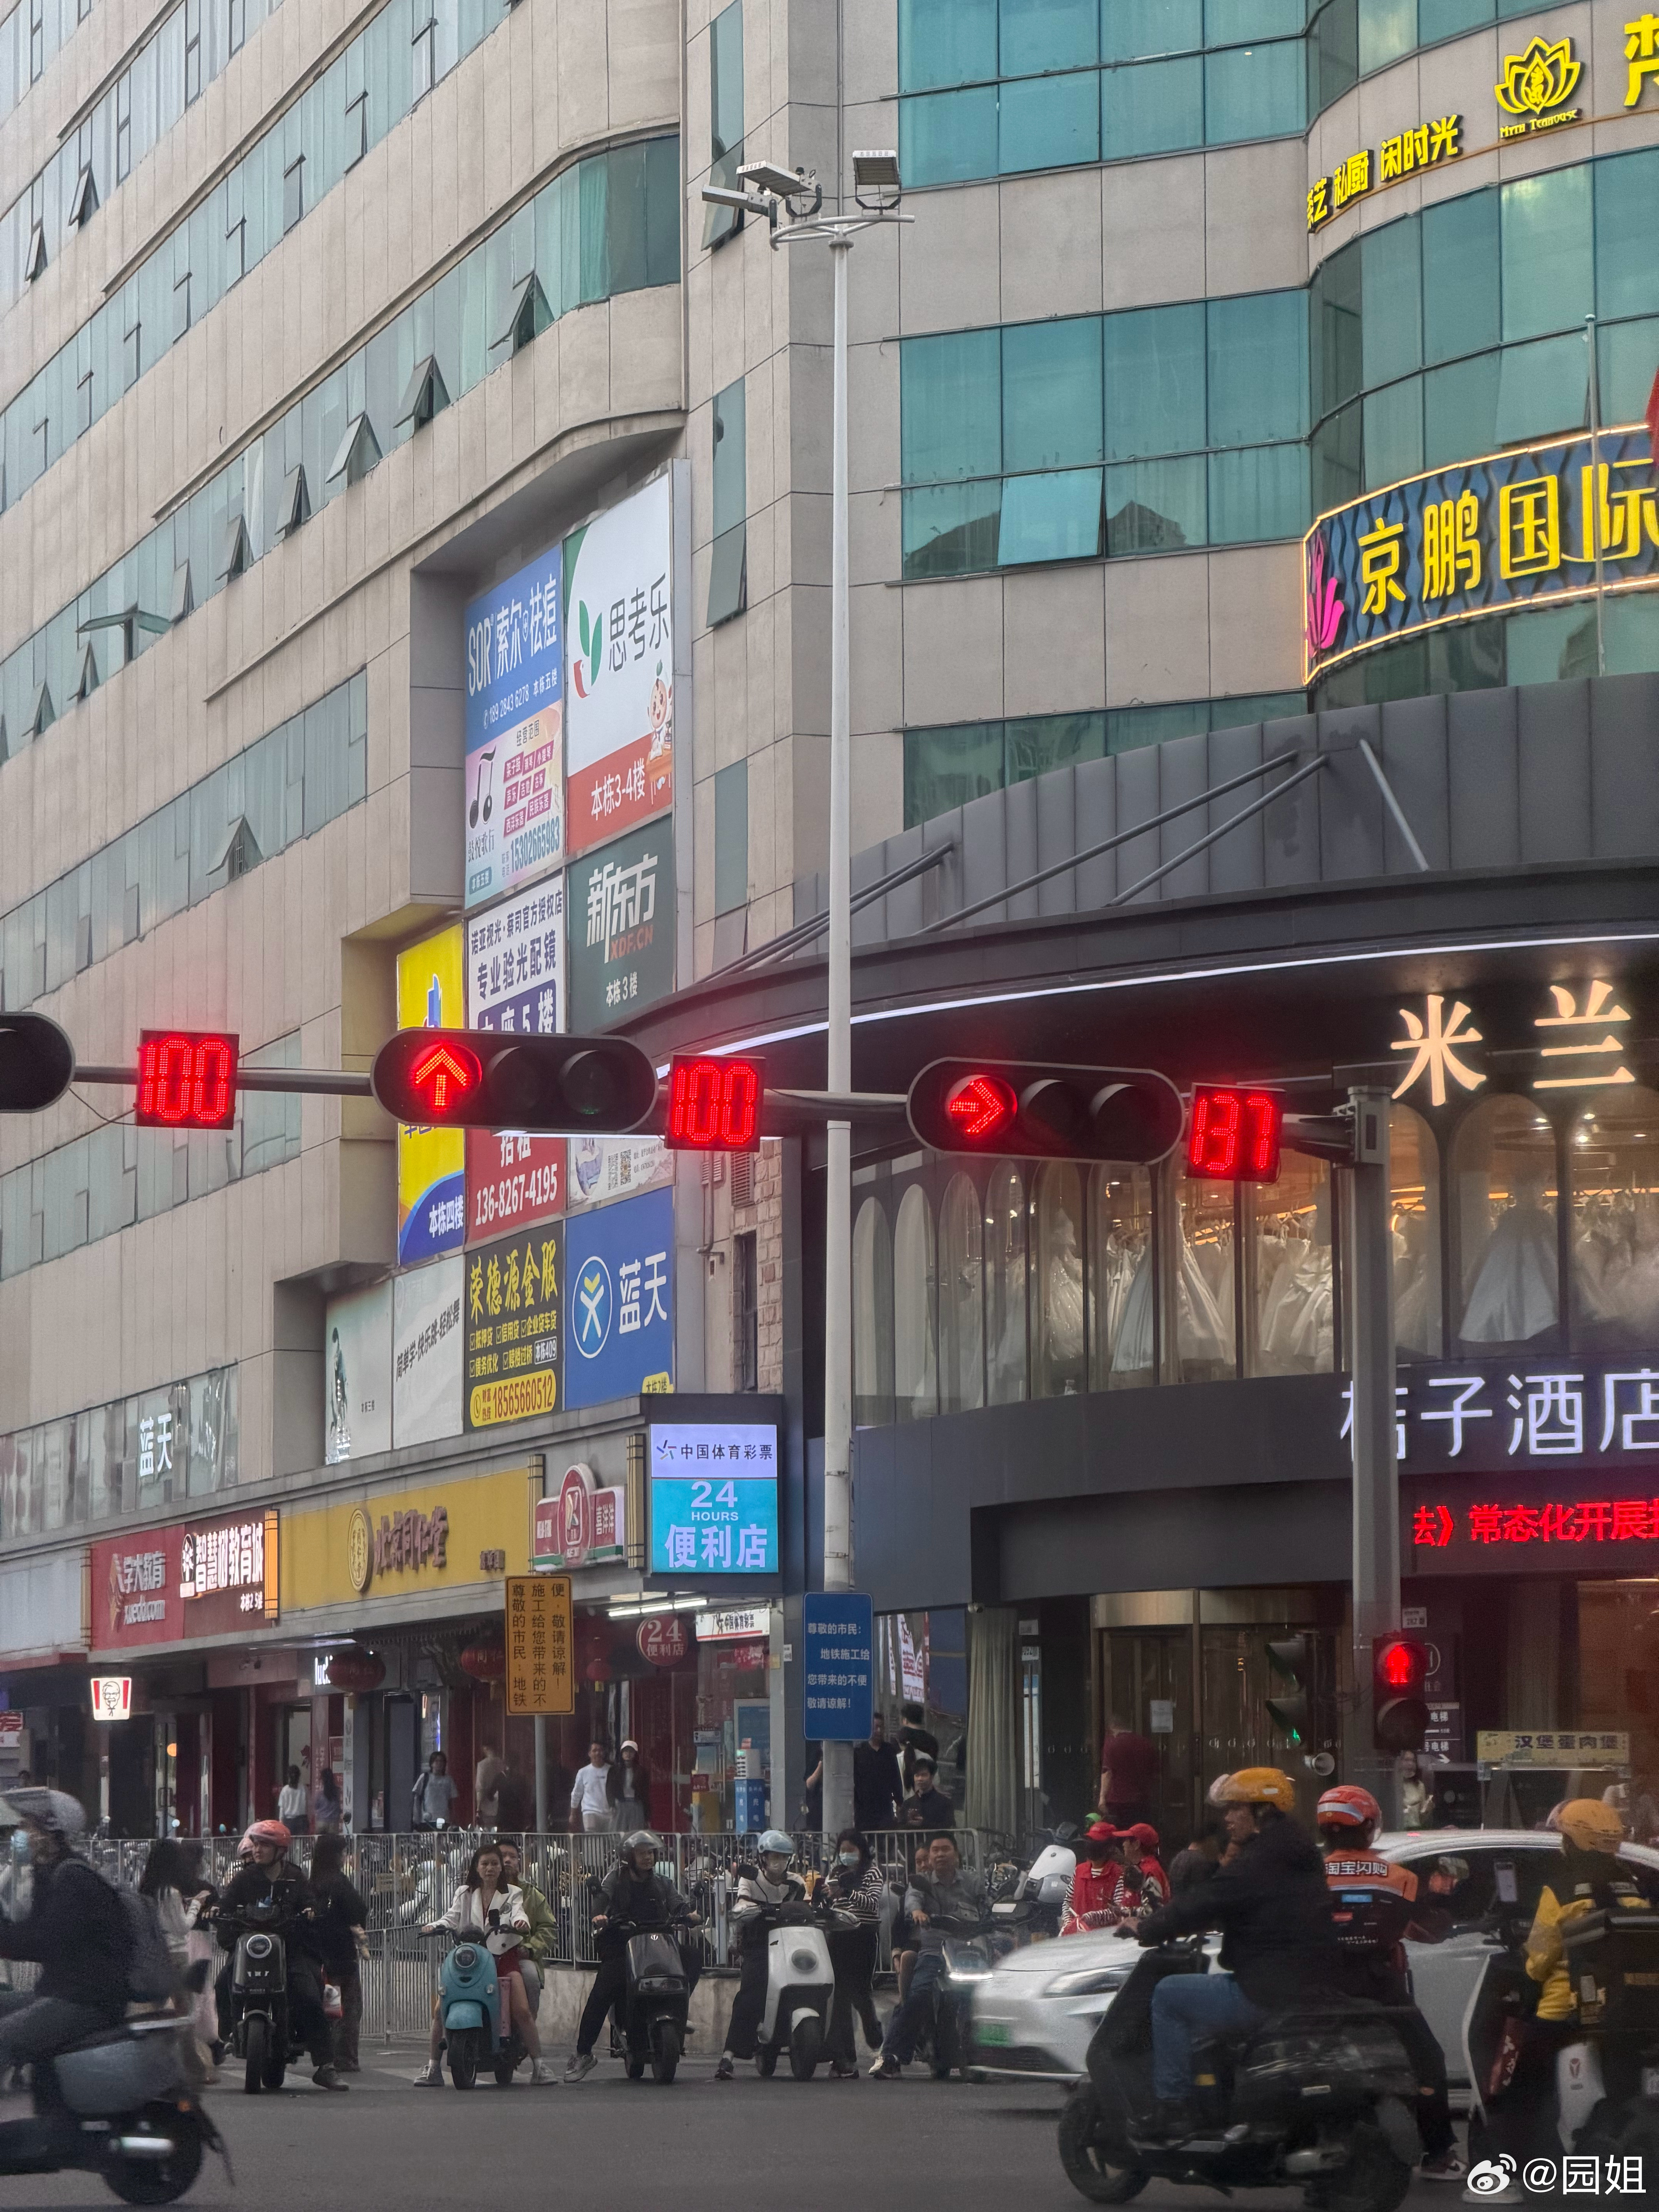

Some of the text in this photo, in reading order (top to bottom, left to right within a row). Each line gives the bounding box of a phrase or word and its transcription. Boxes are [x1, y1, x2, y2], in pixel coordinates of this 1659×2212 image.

[1334, 150, 1369, 208] 私厨
[1381, 115, 1458, 182] 闲时光
[1358, 459, 1659, 615] 京鹏国际
[609, 572, 669, 672] 思考乐
[591, 757, 645, 821] 本栋3-4楼
[511, 816, 560, 873] 15302665983
[587, 854, 658, 964] 新东方
[477, 929, 556, 1000] 专业验光配镜
[609, 924, 654, 961] XDF.CN
[1390, 980, 1635, 1106] 米兰
[142, 1038, 230, 1121] 100
[672, 1064, 757, 1143] 100
[1193, 1094, 1274, 1171] 137
[429, 1195, 464, 1238] 本栋四楼
[476, 1163, 558, 1226] 136-8267-4195
[470, 1238, 558, 1326] 荣德源金服
[619, 1251, 667, 1334] 蓝天
[502, 1320, 519, 1343] 信用贷
[493, 1374, 552, 1419] 18565660512
[140, 1413, 172, 1476] 蓝天
[681, 1444, 773, 1460] 中国体育彩票
[690, 1481, 738, 1508] 24
[692, 1512, 738, 1521] HOURS
[665, 1524, 767, 1568] 便利店
[532, 1584, 546, 1706] 施工给您带来的不
[647, 1619, 682, 1643] 24
[647, 1641, 684, 1657] 便利店
[821, 1649, 870, 1661] 地铁施工给
[808, 1674, 867, 1686] 您带来的不便
[1325, 1860, 1388, 1877] 淘宝闪购
